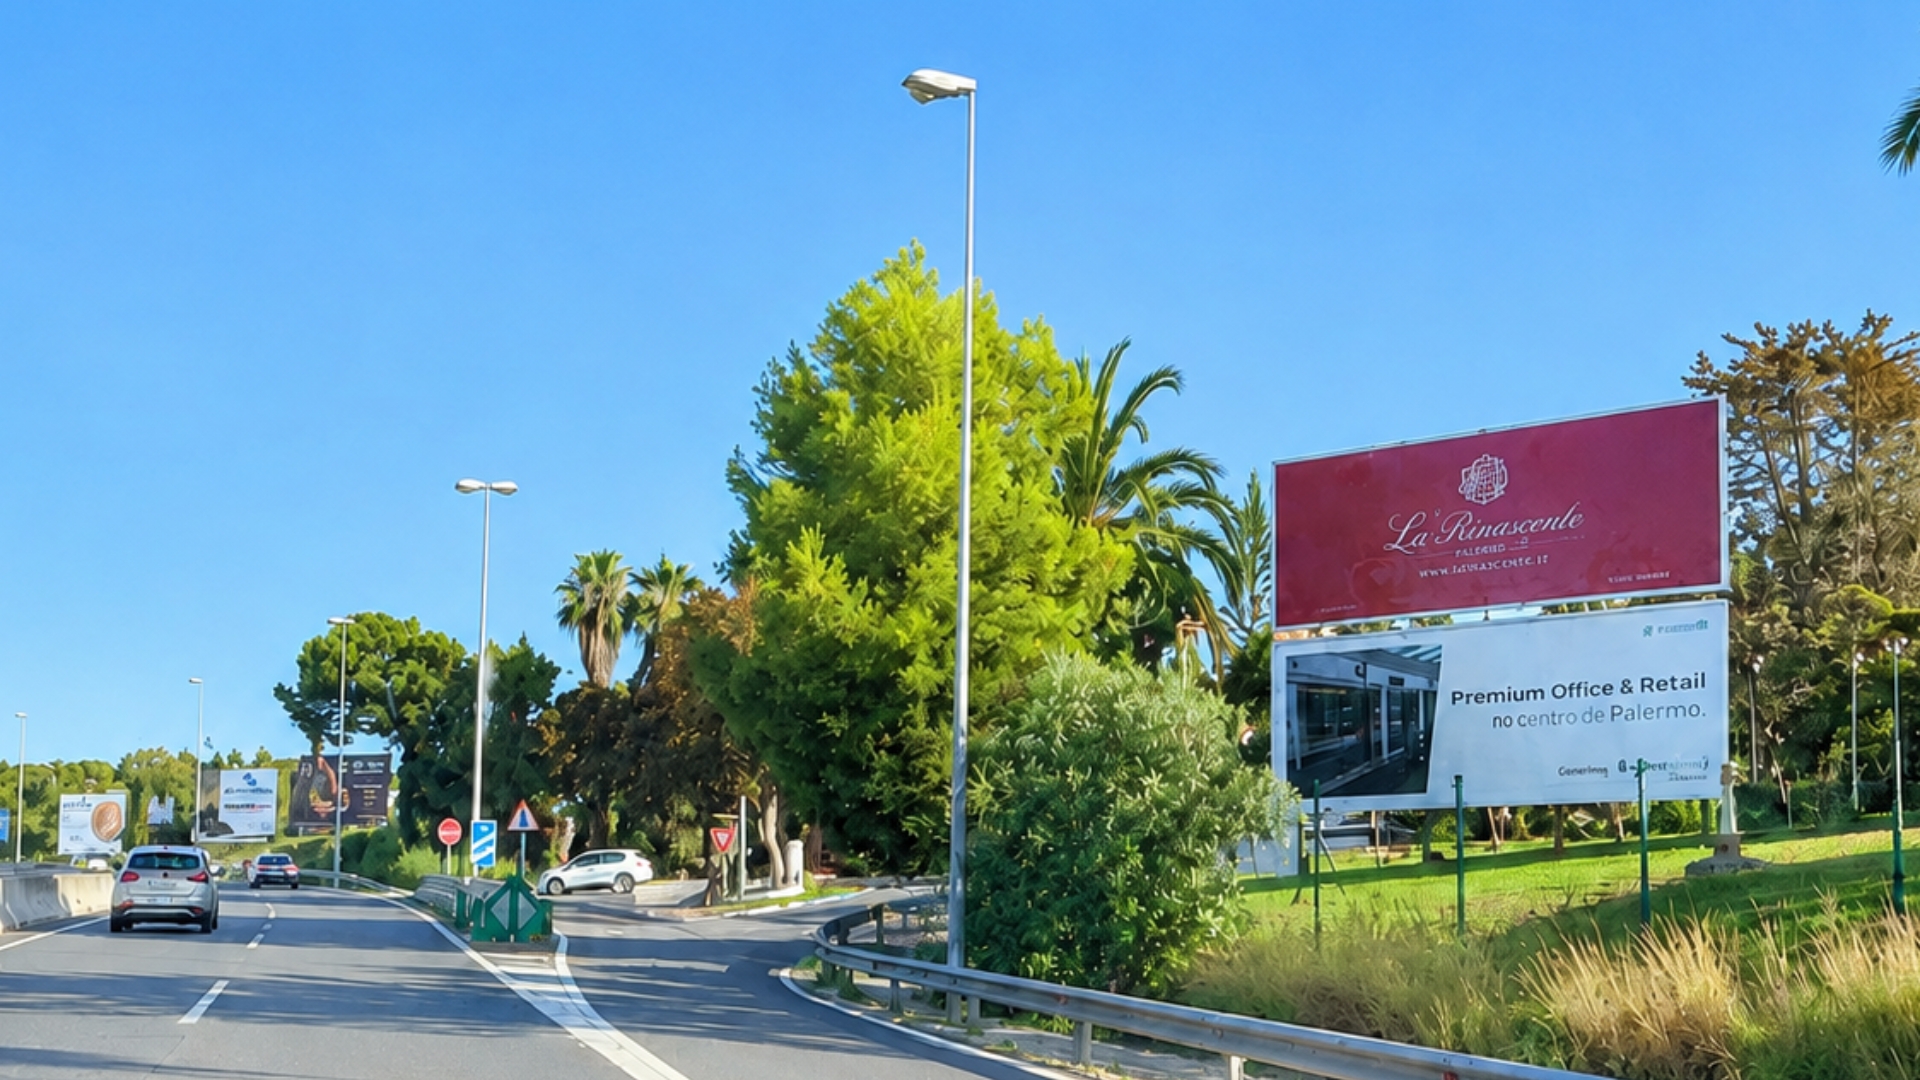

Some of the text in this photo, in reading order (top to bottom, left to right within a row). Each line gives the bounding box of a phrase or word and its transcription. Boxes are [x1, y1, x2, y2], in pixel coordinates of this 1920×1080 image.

[1451, 672, 1706, 706] Premium Office & Retail
[1492, 703, 1706, 729] no centro de Palermo.
